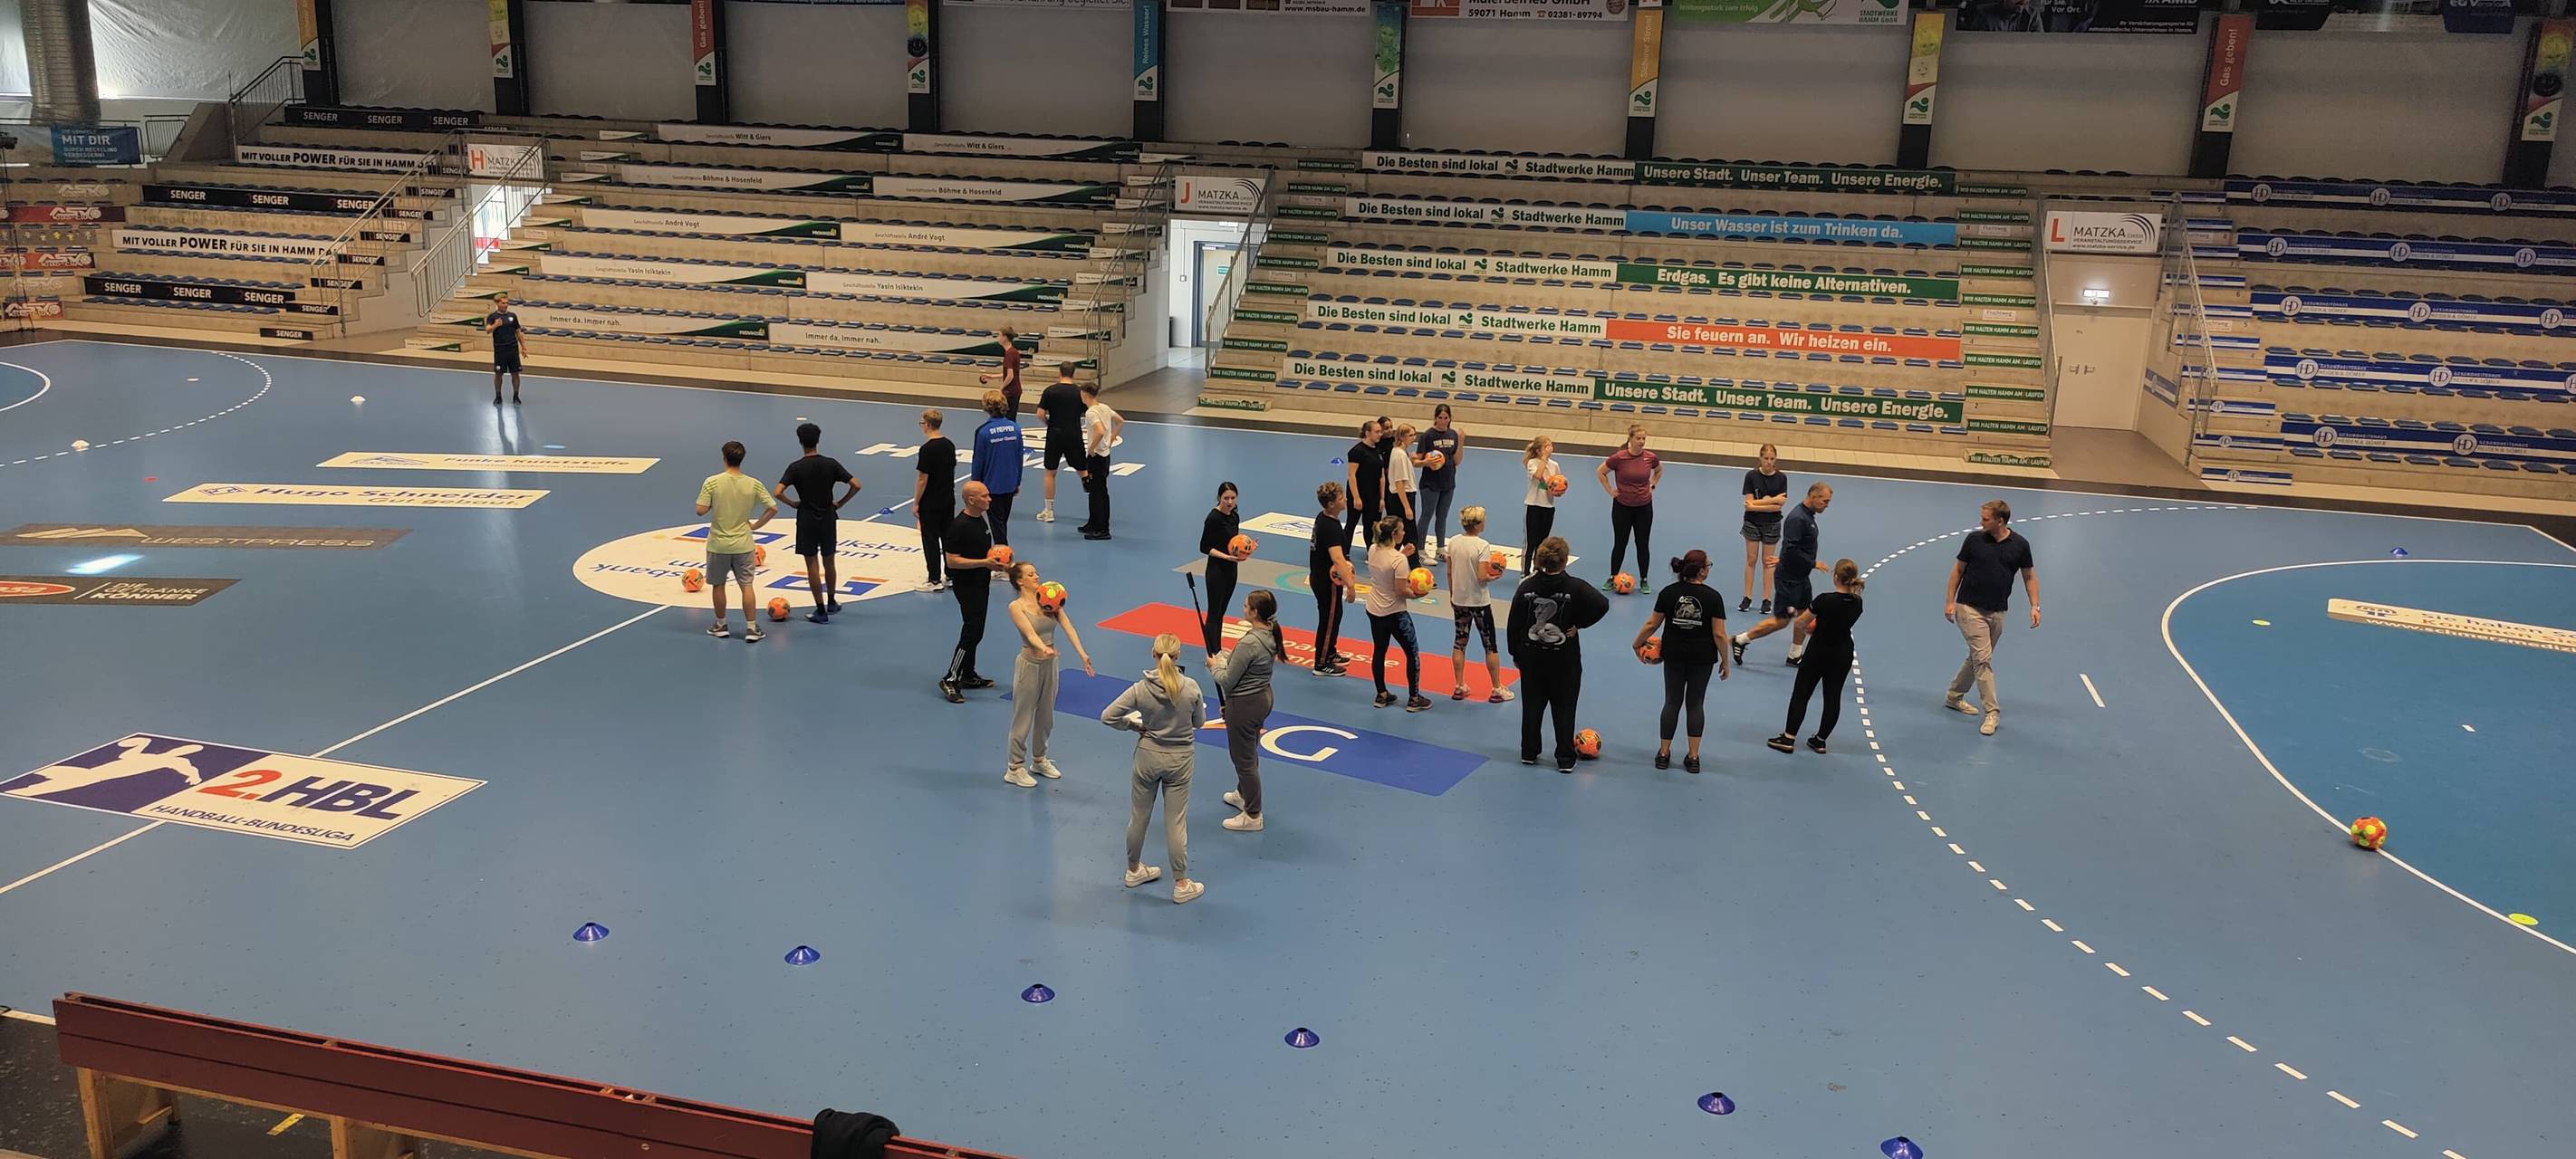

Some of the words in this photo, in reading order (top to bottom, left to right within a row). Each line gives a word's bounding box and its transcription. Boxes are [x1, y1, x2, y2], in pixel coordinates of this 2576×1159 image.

[1468, 9, 1495, 17] 59071
[1500, 9, 1531, 17] Hamm
[1548, 10, 1602, 18] 02381-89794
[699, 32, 707, 47] Gas
[2219, 66, 2231, 87] Gas
[2225, 29, 2239, 64] geben!
[303, 111, 339, 121] SENGER
[368, 115, 403, 125] SENGER
[433, 117, 468, 126] SENGER
[62, 135, 86, 145] MIT
[89, 135, 111, 145] DIR
[241, 151, 257, 161] MIT
[259, 152, 290, 162] VOLLER
[293, 152, 335, 165] POWER
[339, 155, 356, 166] FÜR
[358, 158, 370, 167] SIE
[372, 158, 383, 167] IN
[385, 158, 415, 168] HAMM
[471, 149, 484, 169] H
[1377, 156, 1395, 167] Die
[1399, 157, 1437, 168] Besten
[1441, 158, 1466, 169] sind
[1469, 158, 1497, 171] lokal
[1524, 161, 1592, 176] Stadtwerke
[1597, 165, 1633, 177] Hamm
[703, 174, 723, 183] Böhme
[731, 176, 763, 185] Hosenfeld
[1644, 165, 1690, 178] Unsere
[1693, 167, 1733, 180] Stadt.
[1741, 169, 1781, 182] Unser
[1783, 170, 1823, 184] Team.
[1831, 172, 1880, 186] Unsere
[1884, 173, 1942, 190] Energie.
[170, 190, 206, 200] SENGER
[938, 186, 960, 195] Böhme
[969, 187, 1002, 196] Hosenfeld
[1181, 182, 1189, 203] J
[1197, 190, 1239, 200] MATZKA
[252, 195, 289, 205] SENGER
[337, 199, 374, 210] SENGER
[1359, 202, 1377, 214] Die
[1381, 203, 1421, 216] Besten
[1426, 205, 1450, 217] sind
[1454, 206, 1483, 219] lokal
[1512, 209, 1581, 224] Stadtwerke
[1585, 213, 1624, 225] Hamm
[665, 218, 683, 227] André
[685, 220, 700, 229] Vogt
[1671, 216, 1711, 230] Unser
[1715, 218, 1766, 233] Wasser
[1770, 220, 1788, 233] ist
[1792, 224, 1820, 235] zum
[1824, 222, 1877, 236] Trinken
[1880, 225, 1903, 238] da.
[2051, 218, 2065, 242] L
[2073, 226, 2126, 237] MATZKA
[908, 232, 928, 241] André
[929, 234, 946, 243] Vogt
[122, 236, 140, 245] MIT
[141, 237, 177, 247] VOLLER
[179, 237, 227, 250] POWER
[230, 241, 249, 252] FÜR
[252, 244, 265, 253] SIE
[269, 244, 279, 254] IN
[283, 244, 315, 255] HAMM
[628, 266, 643, 274] Yasin
[1337, 252, 1356, 263] Die
[1360, 253, 1402, 266] Besten
[1406, 255, 1431, 268] sind
[1436, 257, 1466, 271] lokal
[1495, 261, 1567, 275] Stadtwerke
[1572, 264, 1610, 277] Hamm
[877, 283, 894, 291] Yasin
[1657, 268, 1709, 286] Erdgas.
[1717, 271, 1735, 285] Es
[1737, 272, 1767, 290] gibt
[1770, 273, 1811, 288] keine
[1814, 275, 1911, 294] Alternativen.
[104, 283, 141, 293] SENGER
[173, 287, 212, 298] SENGER
[245, 292, 284, 303] SENGER
[550, 315, 572, 324] Immer
[572, 316, 583, 325] da.
[584, 318, 606, 326] Immer
[607, 318, 622, 327] nah.
[1318, 304, 1338, 317] Die
[1341, 306, 1385, 320] Besten
[1389, 309, 1415, 322] sind
[1419, 311, 1450, 324] lokal
[1481, 315, 1555, 330] Stadtwerke
[1560, 320, 1600, 333] Hamm
[276, 330, 303, 338] SENGER
[805, 332, 828, 341] Immer
[829, 334, 840, 342] da.
[841, 335, 863, 343] Immer
[865, 336, 881, 344] nah.
[1667, 326, 1690, 340] Sie
[1694, 327, 1744, 343] feuern
[1747, 332, 1770, 344] an.
[1779, 331, 1805, 347] Wir
[1808, 333, 1859, 350] heizen
[1863, 336, 1891, 352] ein.
[1294, 362, 1314, 375] Die
[1319, 364, 1363, 378] Besten
[1368, 367, 1395, 380] sind
[1399, 369, 1431, 383] lokal
[1465, 374, 1542, 390] Stadtwerke
[1546, 379, 1588, 394] Hamm
[1604, 383, 1658, 399] Unsere
[1661, 387, 1707, 403] Stadt.
[1716, 390, 1762, 407] Unser
[1766, 393, 1812, 410] Team.
[1821, 397, 1877, 414] Unsere
[1881, 399, 1948, 419] Energie.
[255, 487, 348, 500] Hugo
[360, 490, 534, 502] Schneider
[421, 498, 521, 507] gebaut.
[140, 537, 374, 547] WESTPRESS
[2366, 618, 2576, 653] www.schmerzmedizi
[149, 804, 355, 842] HANDBALL-BUNDESLIGA
